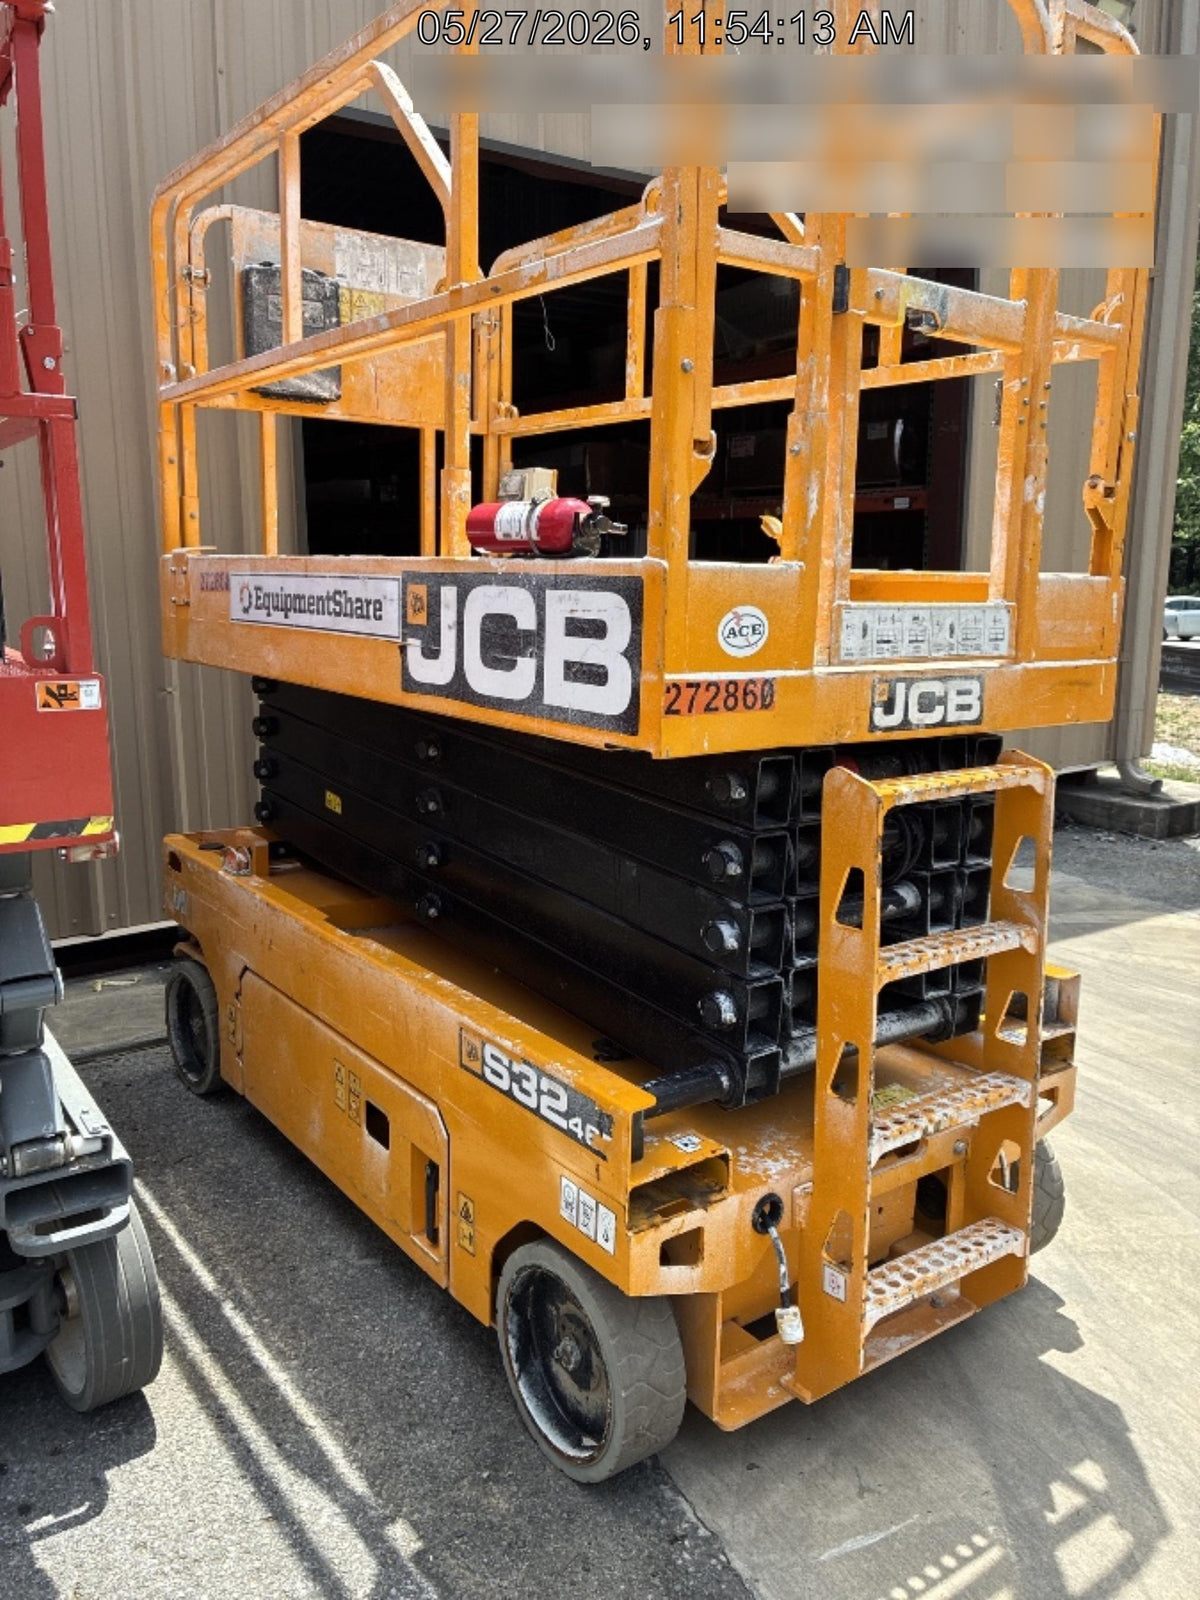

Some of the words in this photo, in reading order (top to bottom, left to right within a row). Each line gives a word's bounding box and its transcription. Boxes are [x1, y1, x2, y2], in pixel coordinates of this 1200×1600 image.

[254, 585, 383, 621] EquipmentShare
[406, 585, 632, 715] JCB
[726, 623, 762, 639] ACE
[664, 677, 776, 715] 272860
[872, 680, 981, 727] JCB
